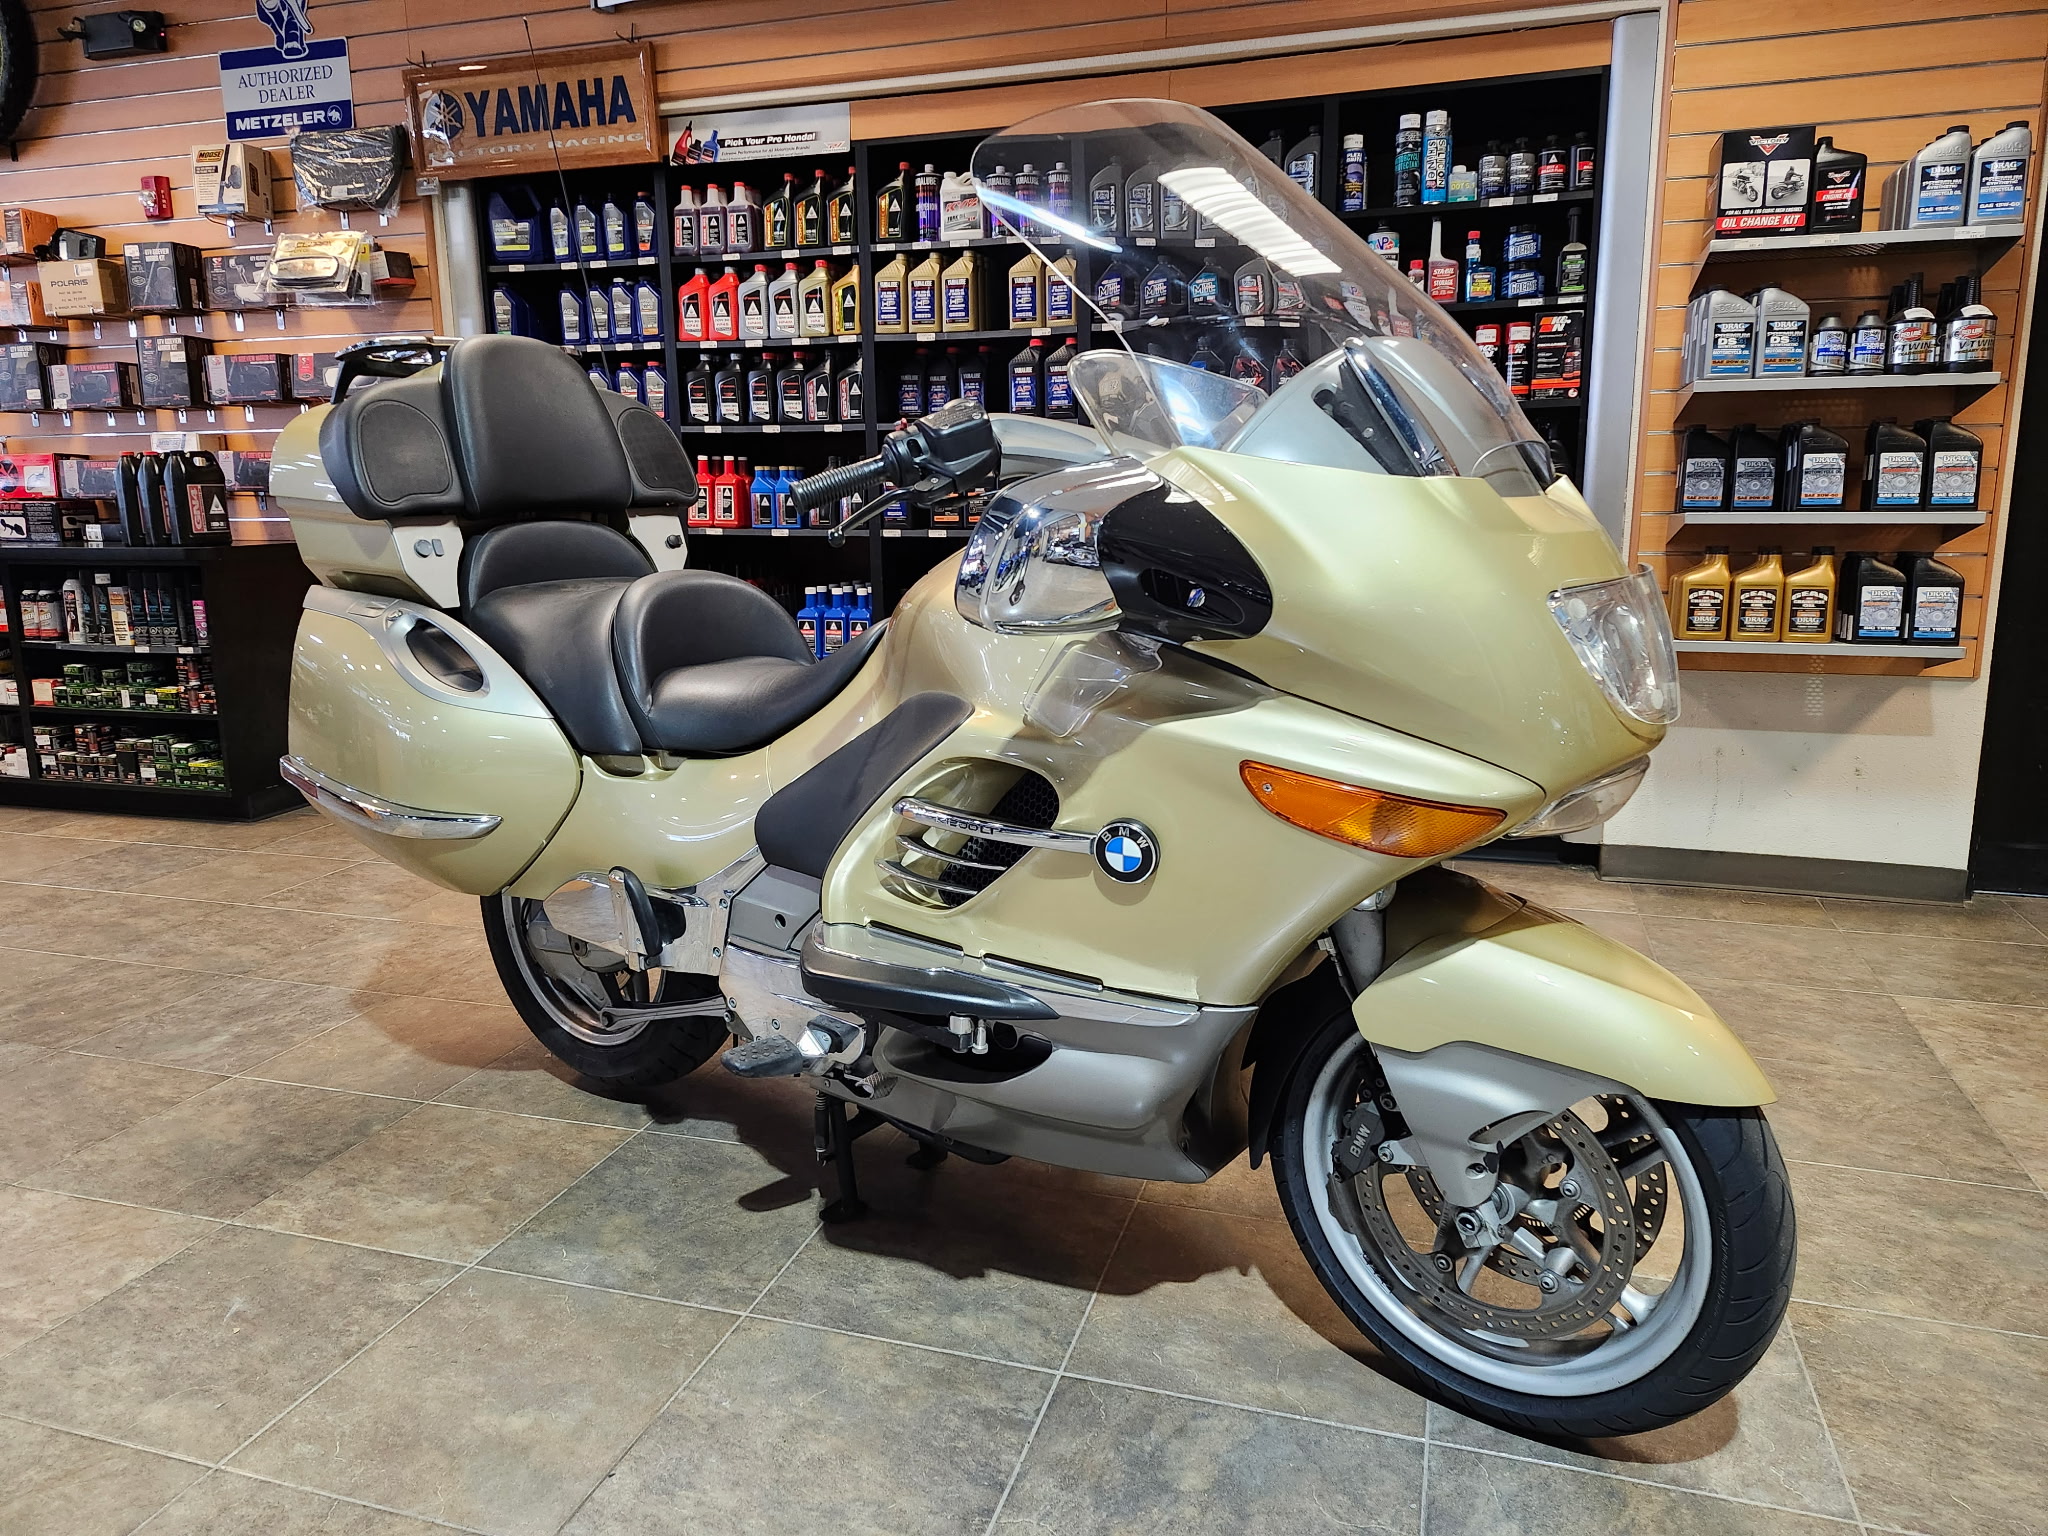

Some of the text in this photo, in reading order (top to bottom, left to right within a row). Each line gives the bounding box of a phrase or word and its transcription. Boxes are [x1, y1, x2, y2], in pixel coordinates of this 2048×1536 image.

[238, 64, 333, 89] AUTHORIZED
[259, 84, 316, 104] DEALER
[463, 75, 637, 138] YAMAHA
[235, 110, 326, 131] METZELER
[547, 132, 645, 149] RACING
[724, 132, 816, 147] Pick Your Pro Honda!
[1750, 137, 1789, 146] VICTORY
[198, 150, 222, 159] MOOSE
[1437, 139, 1447, 188] SILICON
[1990, 160, 2018, 170] DRAG
[1930, 165, 1957, 174] DRAG
[1451, 182, 1464, 190] DOT
[1980, 186, 2014, 194] MOTORCYCLE
[1920, 190, 1953, 198] MOTORCYCLE
[1721, 214, 1801, 228] OIL CHANGE KIT
[51, 279, 88, 287] POLARIS
[1433, 278, 1454, 287] STORAGE
[1900, 330, 1922, 339] RED LINE
[1961, 326, 1984, 336] RED LINE
[189, 487, 203, 530] GN4
[1689, 589, 1724, 600] GEAR
[1740, 590, 1777, 601] GEAR
[1791, 590, 1828, 601] GEAR
[1349, 1123, 1371, 1158] BMW
